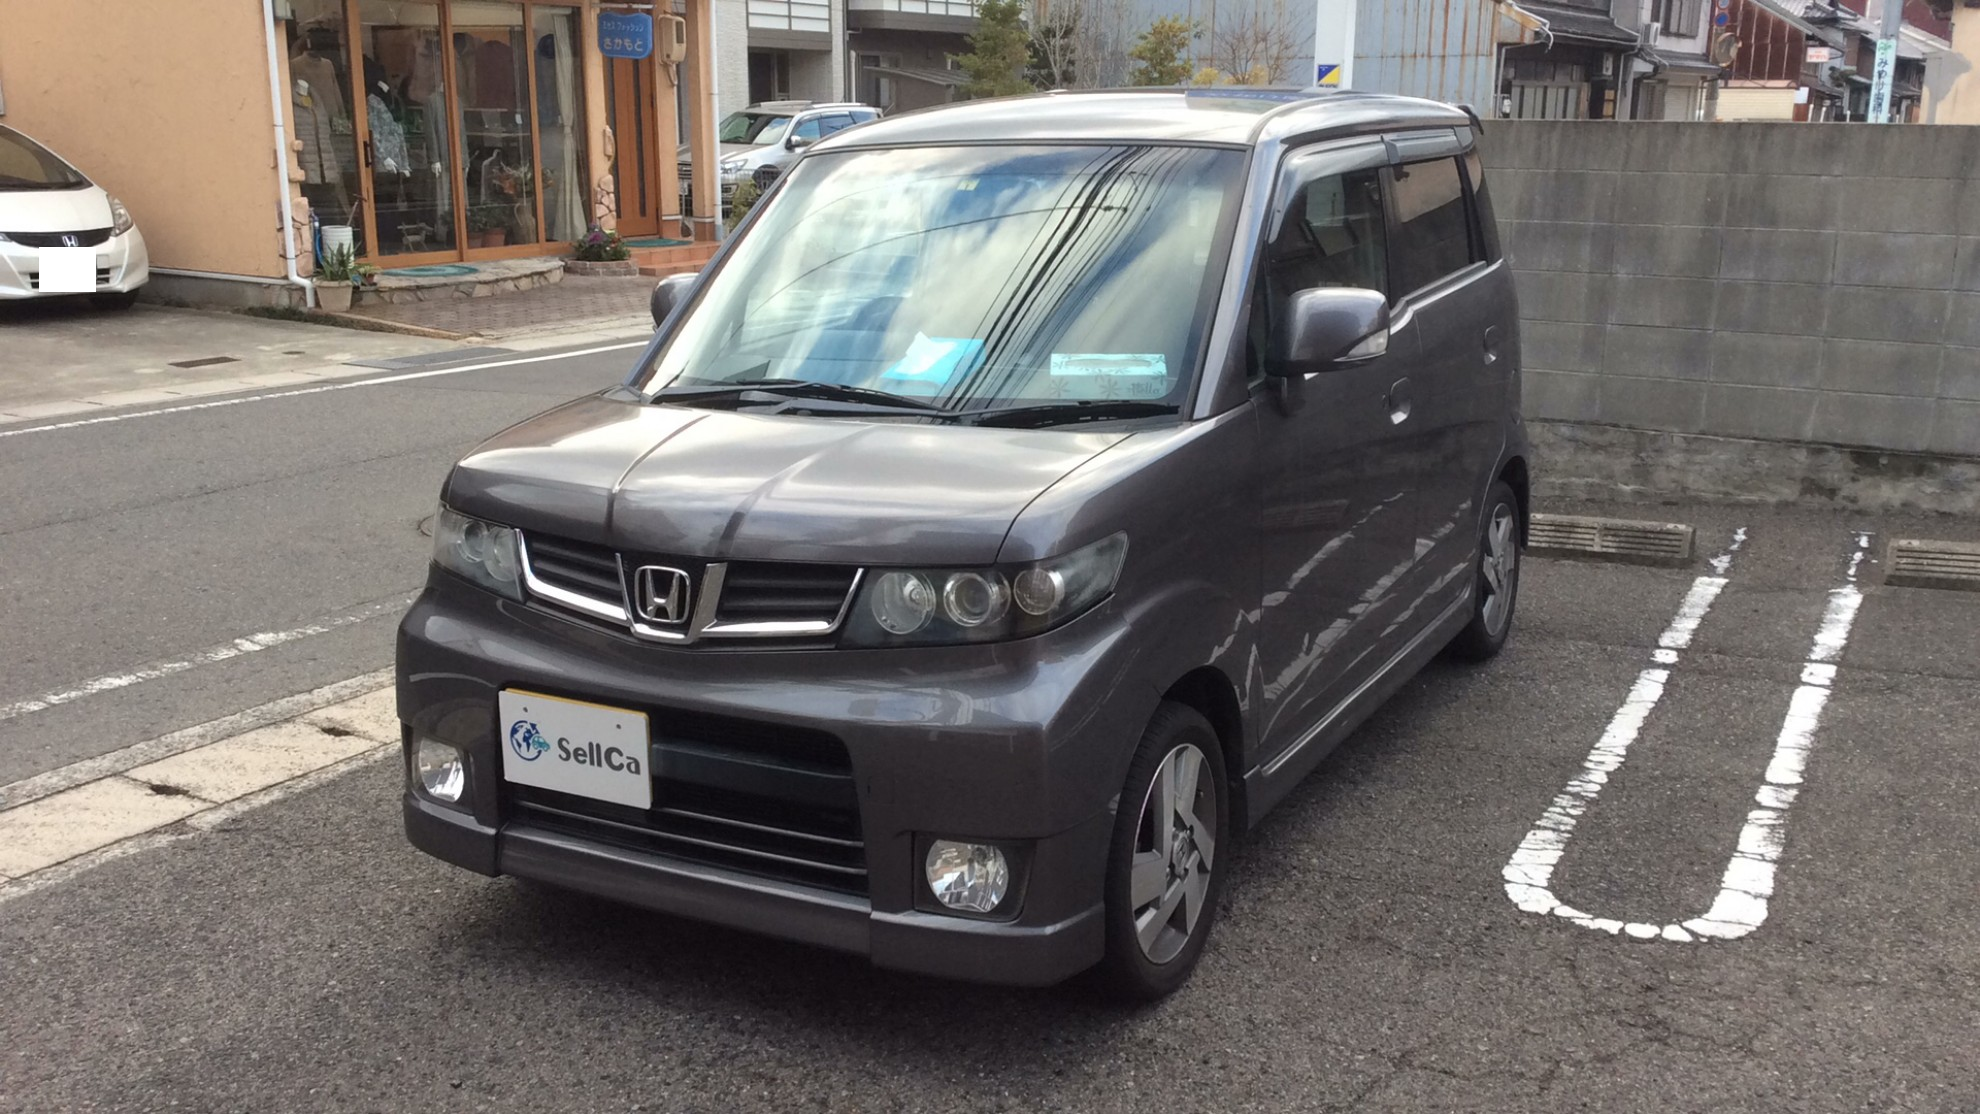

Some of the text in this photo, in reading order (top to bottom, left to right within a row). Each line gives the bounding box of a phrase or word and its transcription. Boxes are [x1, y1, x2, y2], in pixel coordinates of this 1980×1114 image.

[603, 37, 643, 52] さかもと
[557, 737, 641, 775] SellCa
